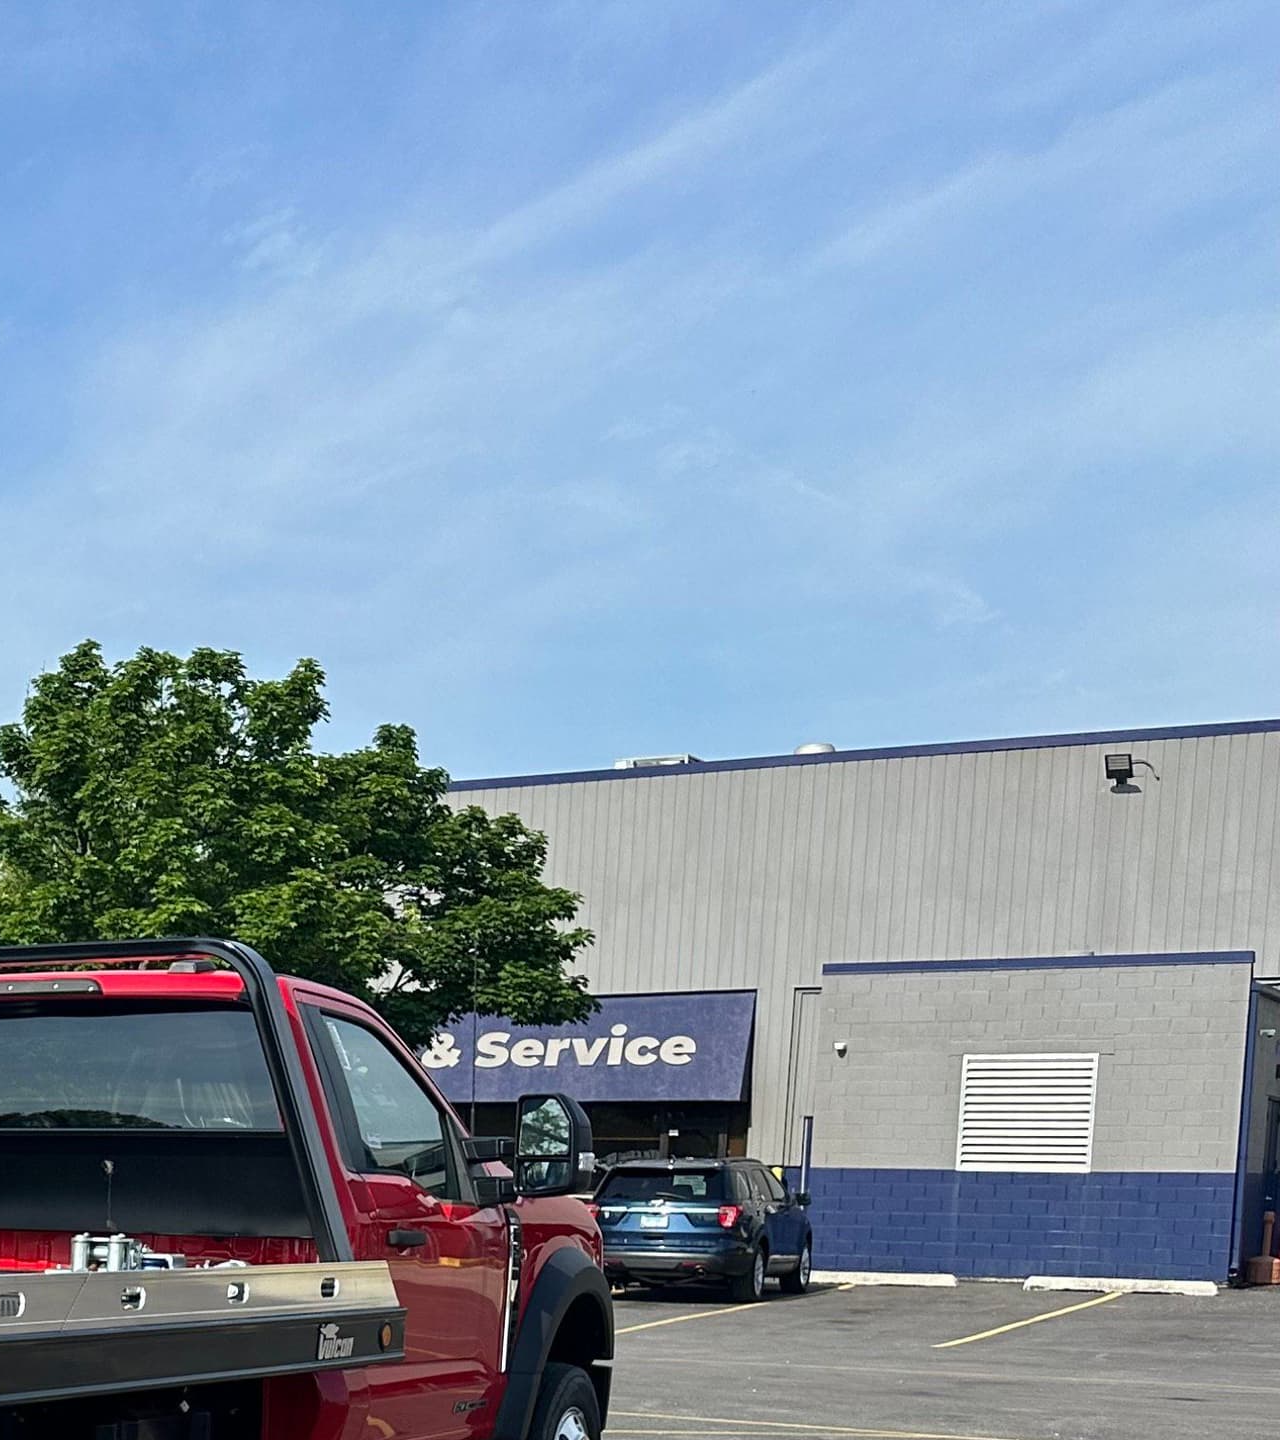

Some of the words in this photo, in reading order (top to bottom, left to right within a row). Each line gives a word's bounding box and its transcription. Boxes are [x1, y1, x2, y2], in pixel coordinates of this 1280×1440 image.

[421, 1033, 461, 1068] &
[474, 1024, 696, 1067] Service
[317, 1331, 355, 1361] Vulcan
